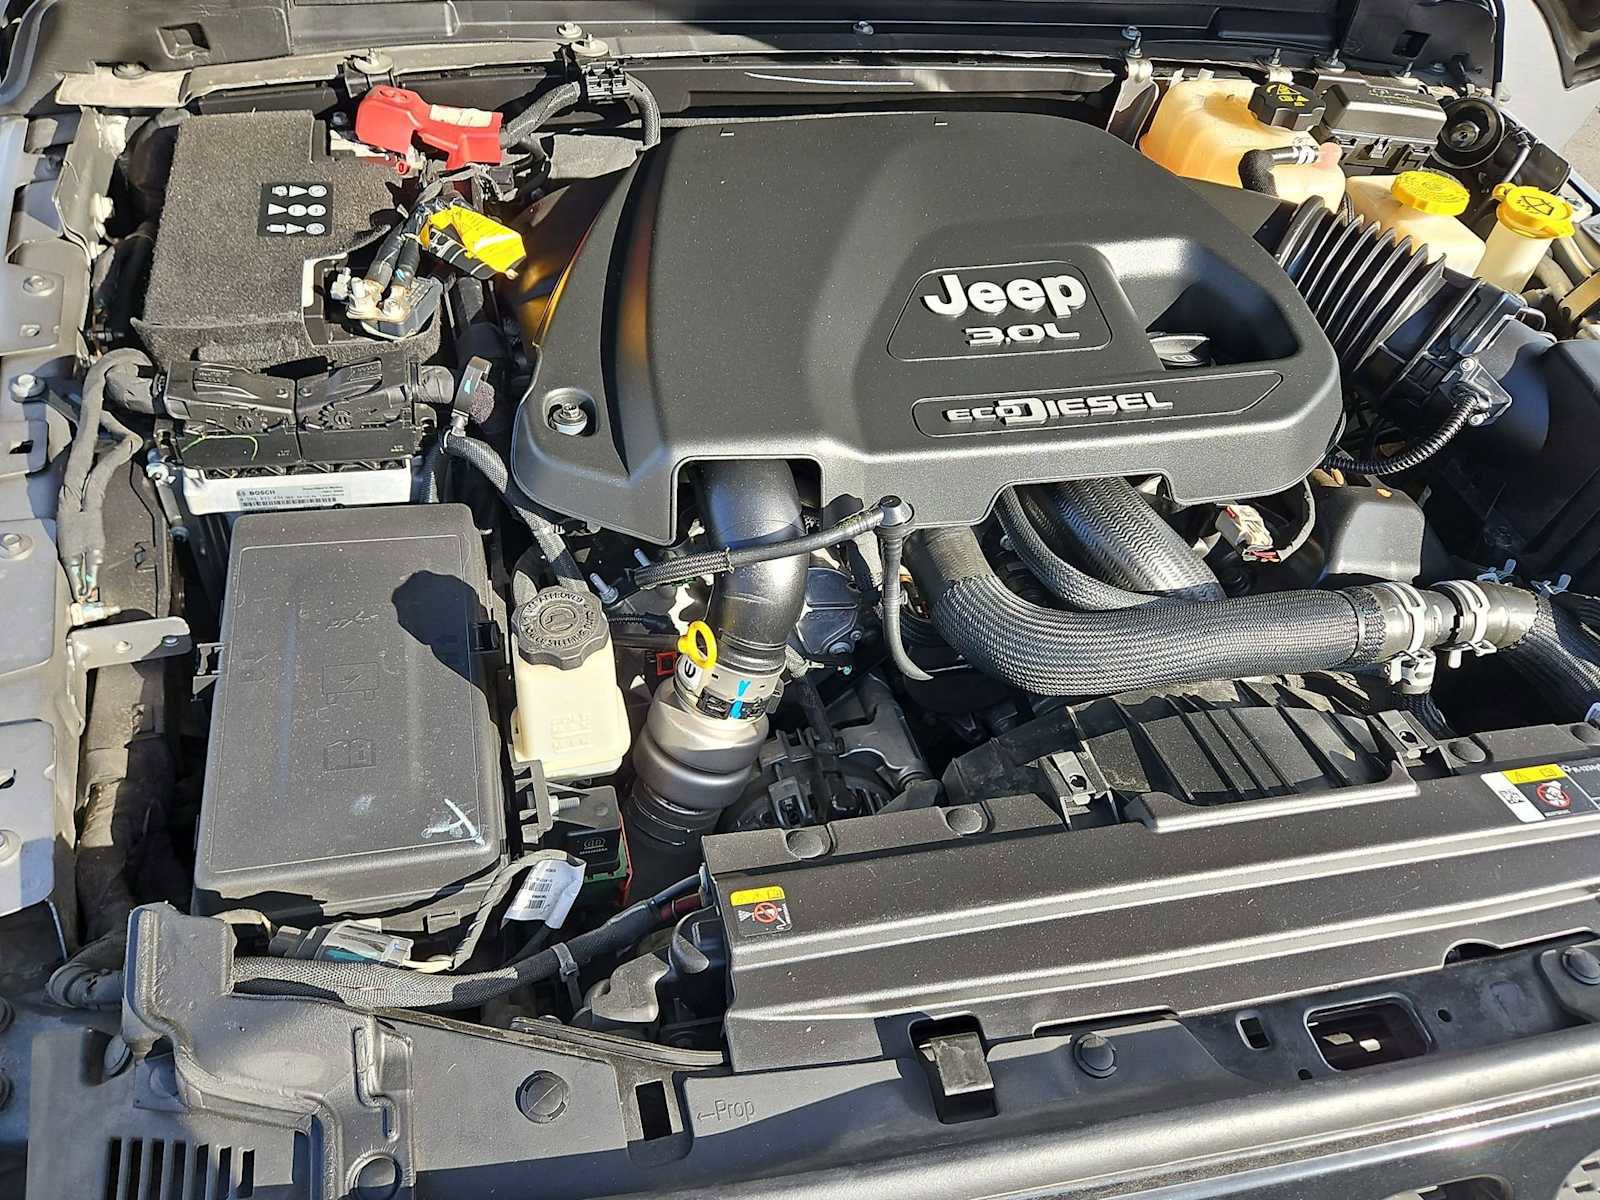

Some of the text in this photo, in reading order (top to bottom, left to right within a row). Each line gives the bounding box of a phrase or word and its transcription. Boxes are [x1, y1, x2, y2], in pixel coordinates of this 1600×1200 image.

[922, 273, 1087, 319] Jeep
[962, 322, 1081, 347] 3.0L
[714, 1098, 755, 1122] Prop
